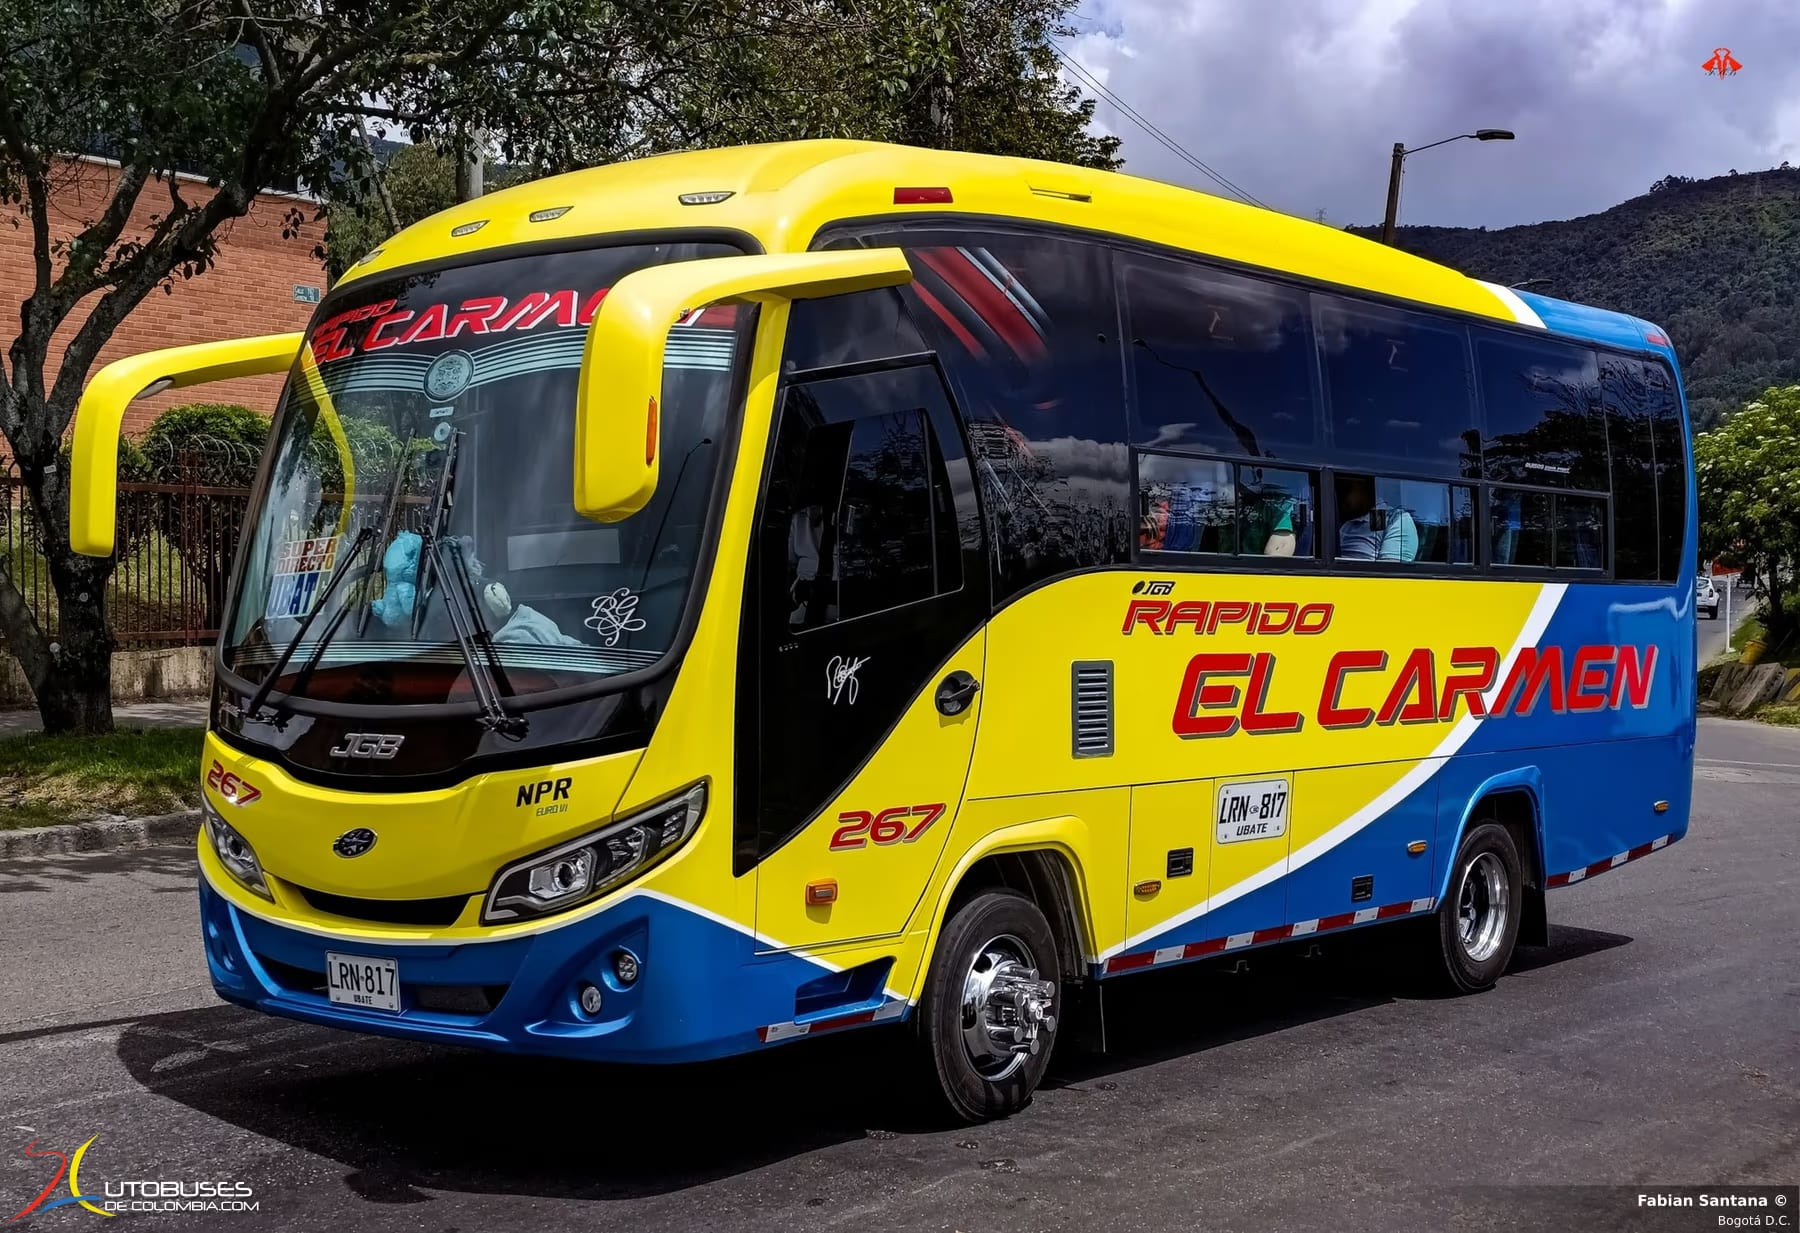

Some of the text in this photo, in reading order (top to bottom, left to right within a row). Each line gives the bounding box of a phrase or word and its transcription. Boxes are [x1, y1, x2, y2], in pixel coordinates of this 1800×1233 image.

[279, 539, 338, 559] SUPER
[1122, 600, 1334, 635] RAPIDO
[1172, 645, 1658, 740] EL CARMEN
[330, 732, 405, 760] JGB
[206, 759, 262, 807] 267
[516, 777, 572, 808] NPR
[536, 804, 558, 817] EURO
[829, 803, 946, 851] 267
[1236, 823, 1268, 836] UBATE
[353, 994, 373, 1005] UBATE
